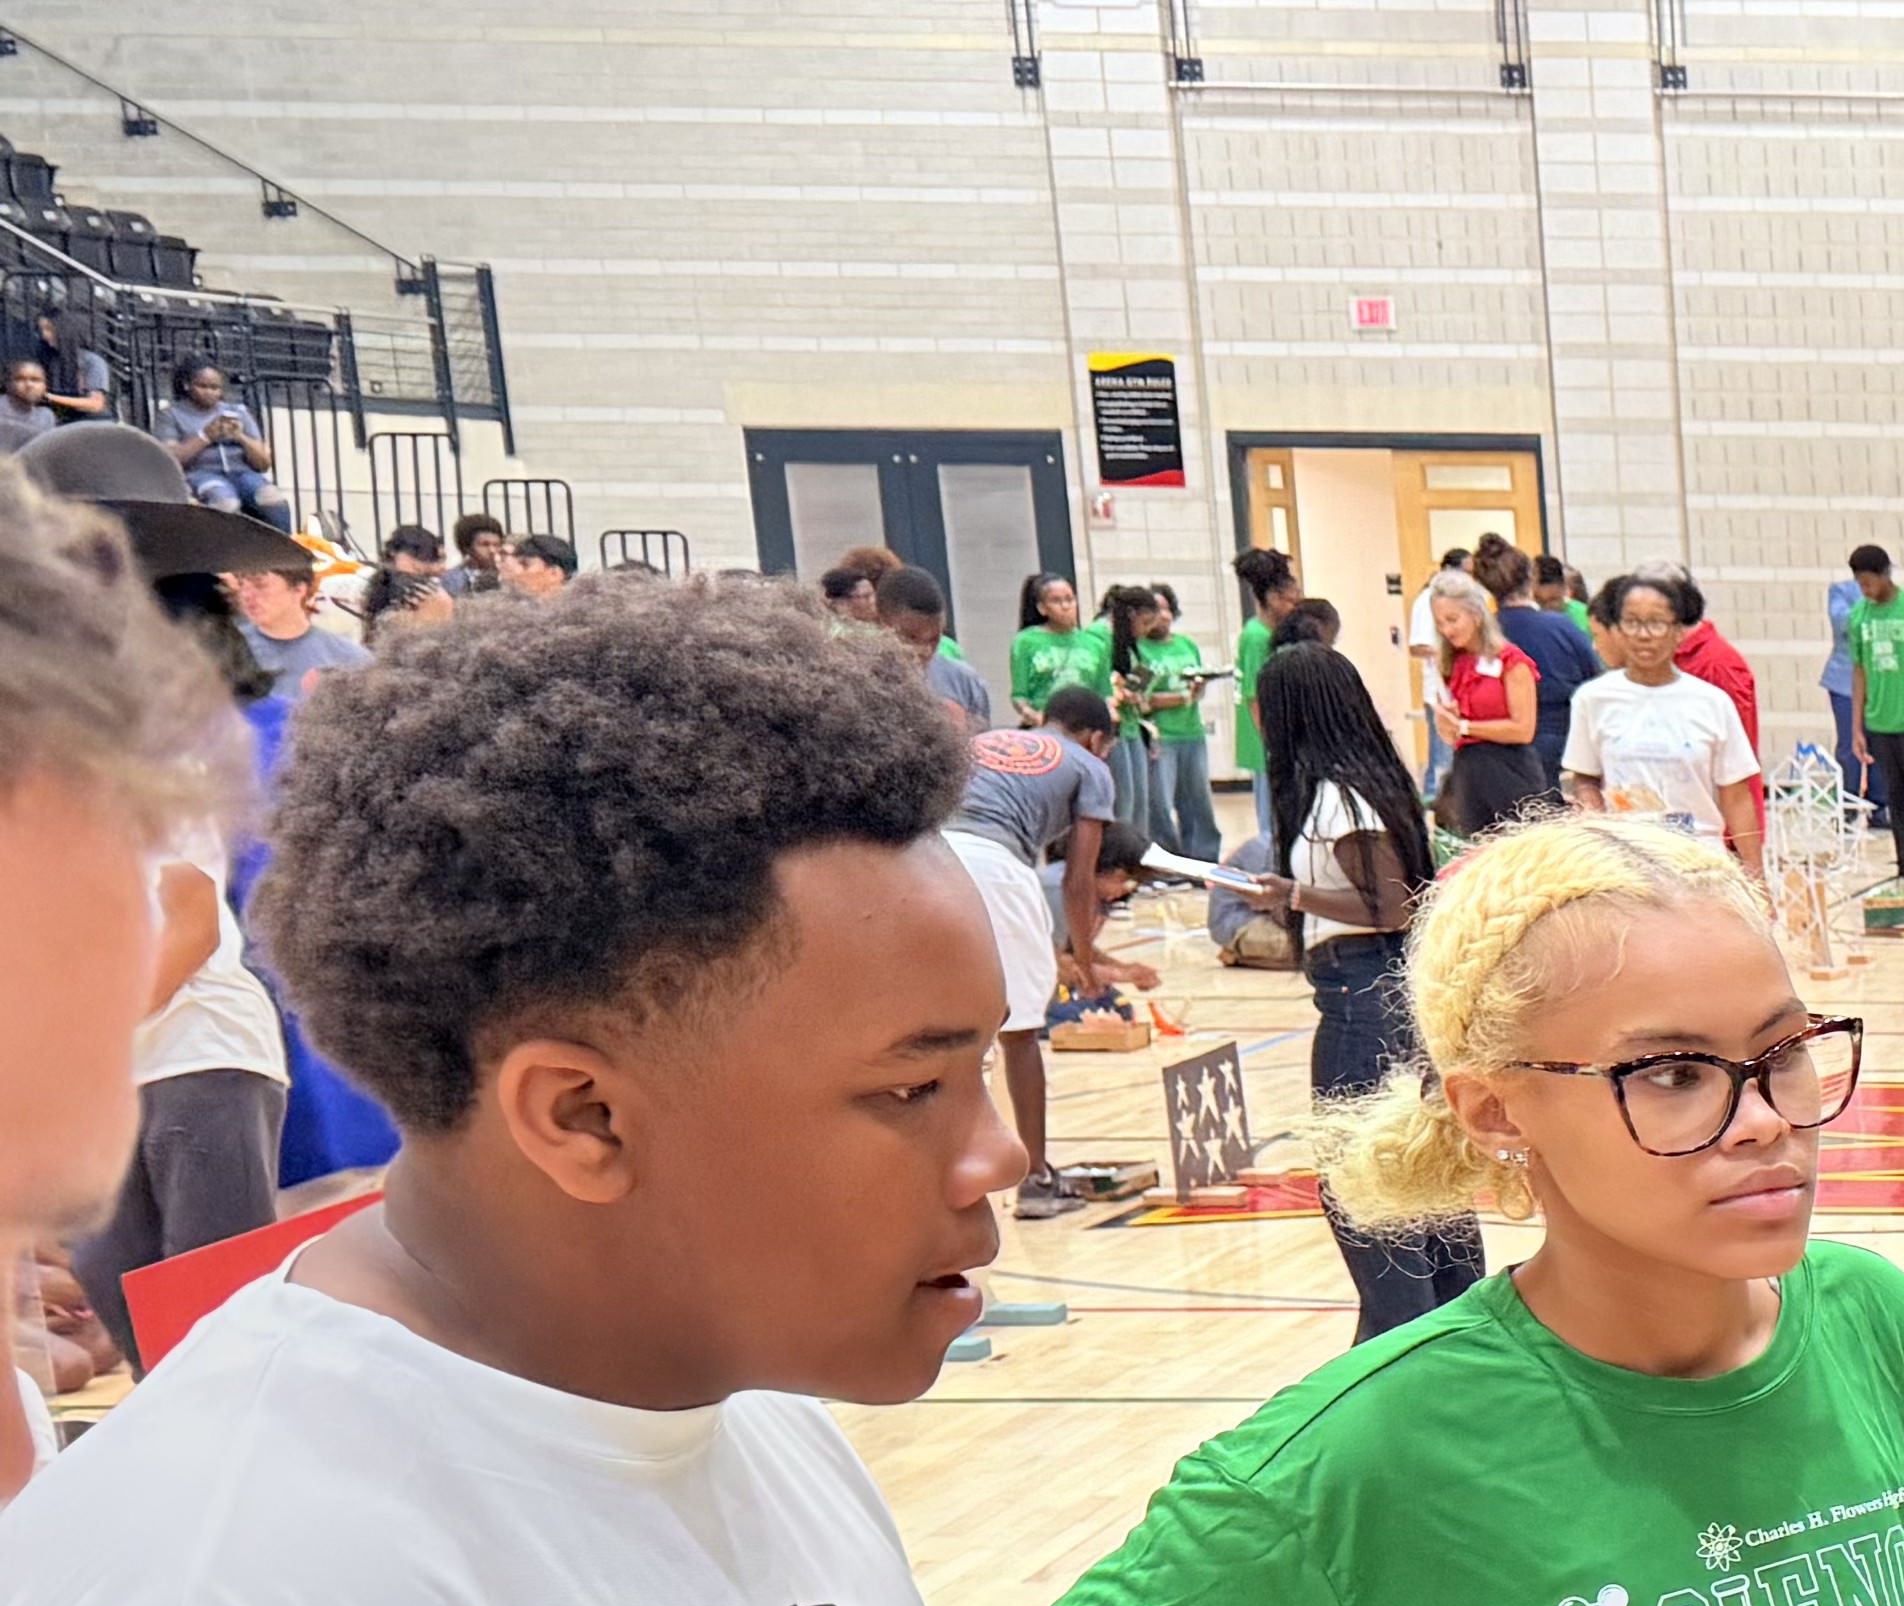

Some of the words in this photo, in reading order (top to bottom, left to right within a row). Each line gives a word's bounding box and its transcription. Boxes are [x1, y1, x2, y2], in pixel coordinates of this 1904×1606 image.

[1745, 1521, 1806, 1547] Charles
[1807, 1511, 1829, 1530] H.
[1829, 1496, 1883, 1524] Flowers
